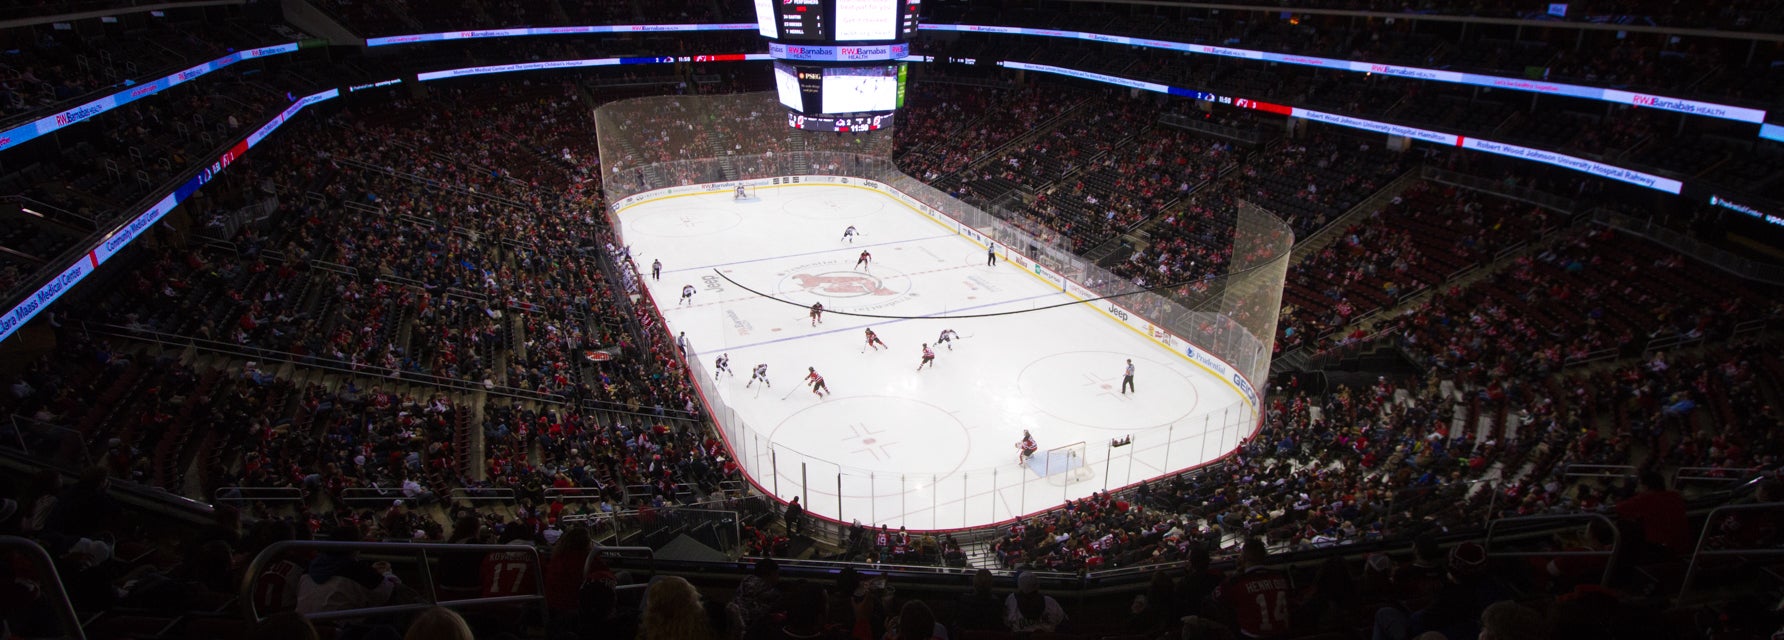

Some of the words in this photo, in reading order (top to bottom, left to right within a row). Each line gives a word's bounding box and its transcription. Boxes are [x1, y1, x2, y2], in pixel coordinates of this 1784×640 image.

[788, 46, 832, 56] RWJBarnabas
[842, 47, 886, 56] RWJBarnabas
[1633, 94, 1695, 112] RWJBarnabas
[1696, 107, 1726, 116] HEALTH
[1306, 110, 1323, 120] Robert
[1324, 114, 1340, 122] Wood
[1340, 116, 1362, 126] Johnson
[1363, 120, 1390, 132] University
[1392, 125, 1416, 136] Hospital
[1418, 130, 1446, 141] Hamilton
[1476, 140, 1500, 150] Robert
[1502, 144, 1524, 155] Wood
[1526, 147, 1556, 160] Johnson
[1558, 154, 1592, 172] University
[1592, 162, 1624, 178] Hospital
[1625, 170, 1656, 187] Rahway
[15, 299, 38, 321] Maass
[37, 278, 62, 304] Medical
[61, 266, 82, 286] Center
[1108, 303, 1128, 322] Jeep
[1196, 351, 1226, 376] Prudential
[1233, 373, 1257, 406] GEICO
[490, 562, 527, 592] 17
[1256, 590, 1290, 630] 14
